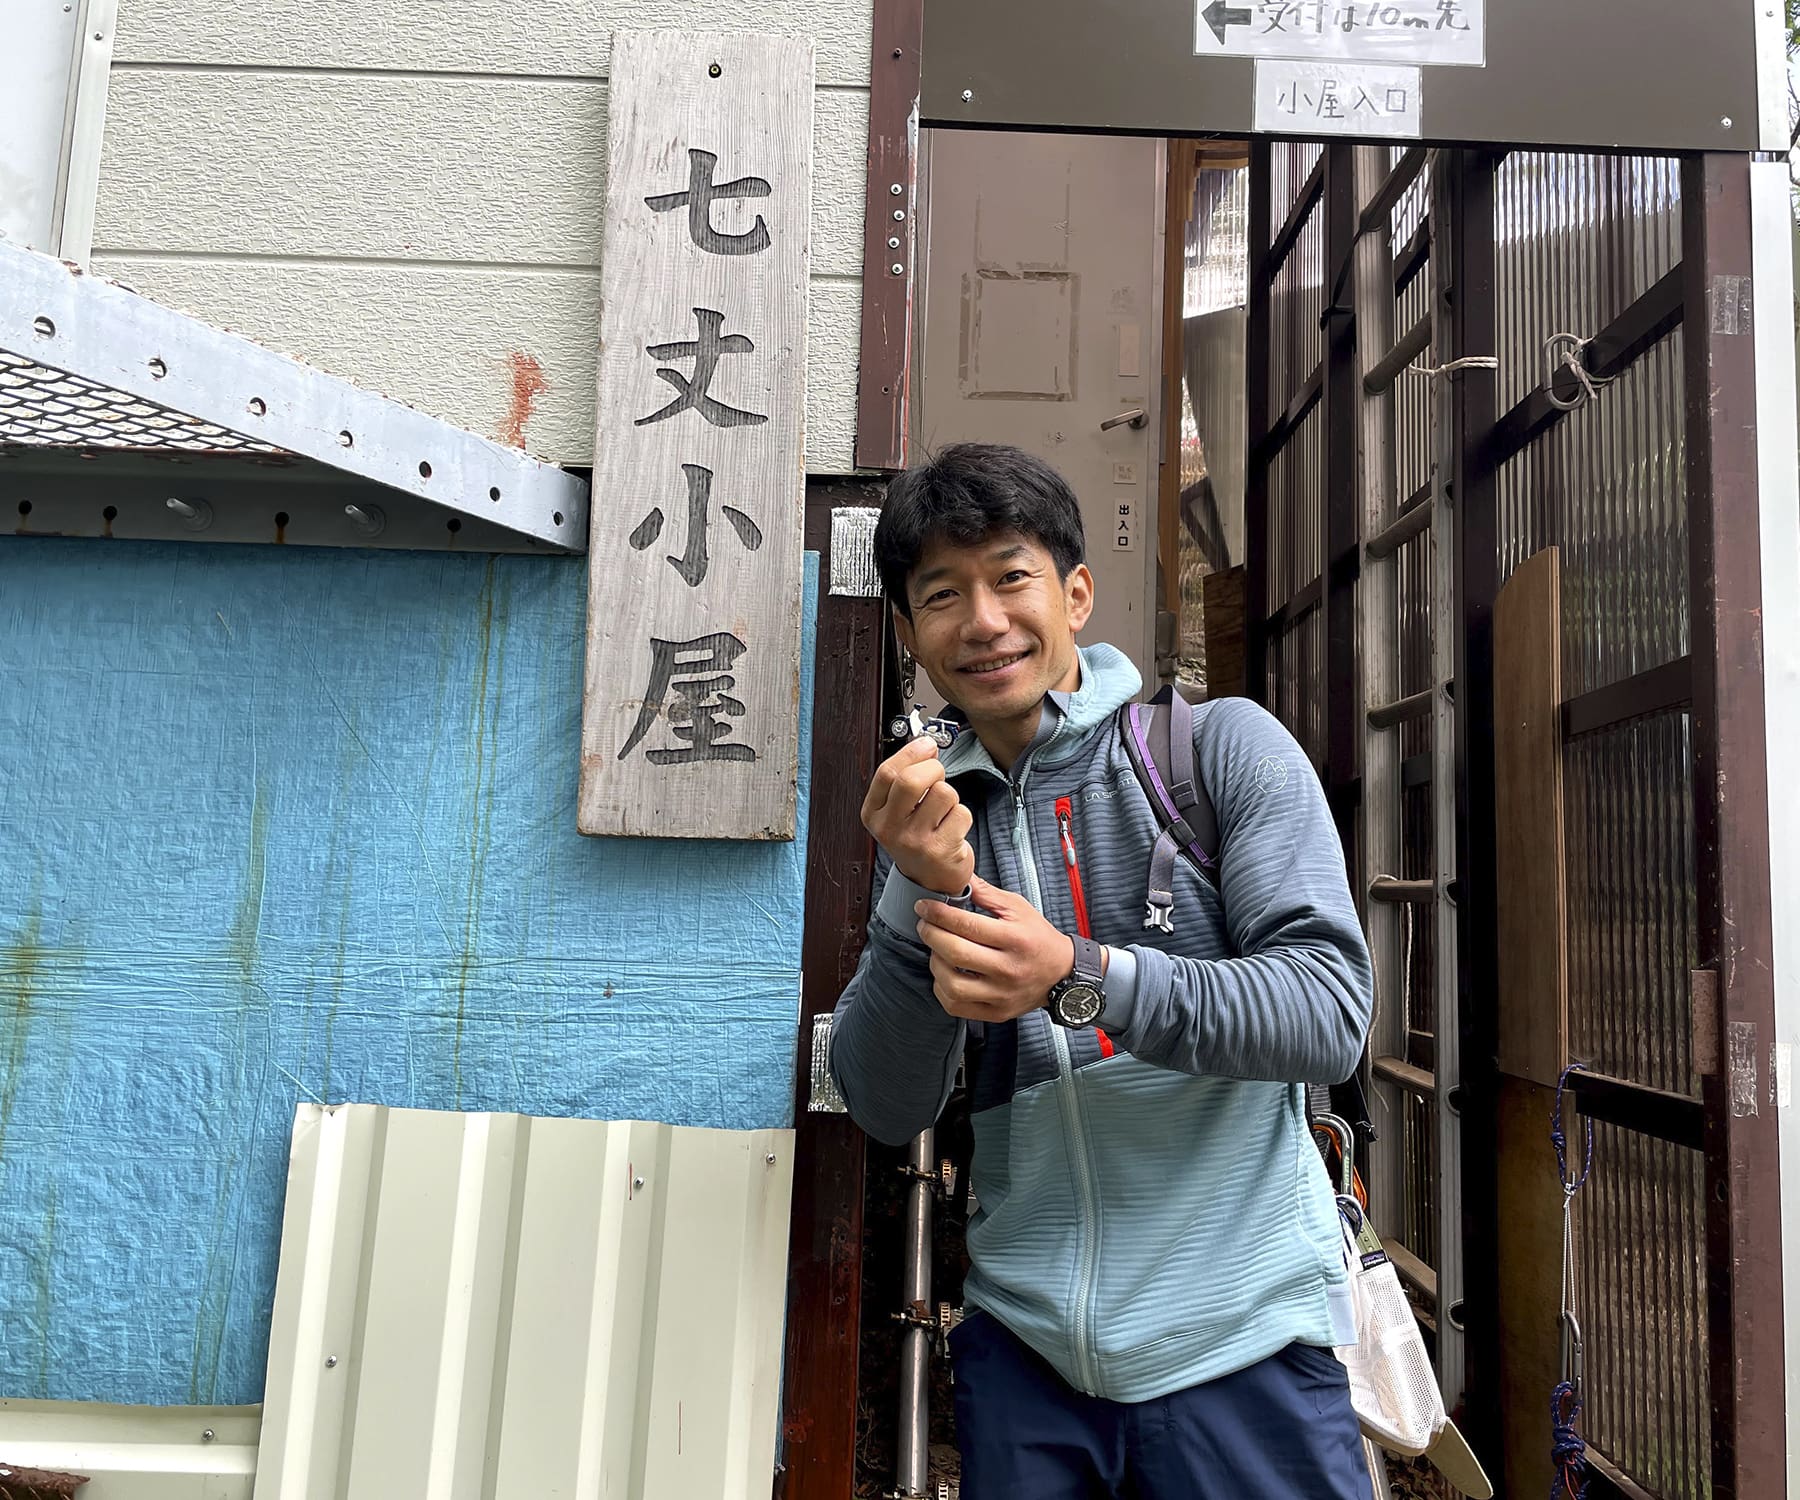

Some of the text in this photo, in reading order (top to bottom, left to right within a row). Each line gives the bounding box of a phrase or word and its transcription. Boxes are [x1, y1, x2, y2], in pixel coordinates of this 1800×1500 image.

[1257, 0, 1471, 33] 受付は10m先
[1278, 79, 1406, 119] 小屋入口
[617, 147, 772, 765] 七丈小屋
[1117, 504, 1130, 546] 出入口
